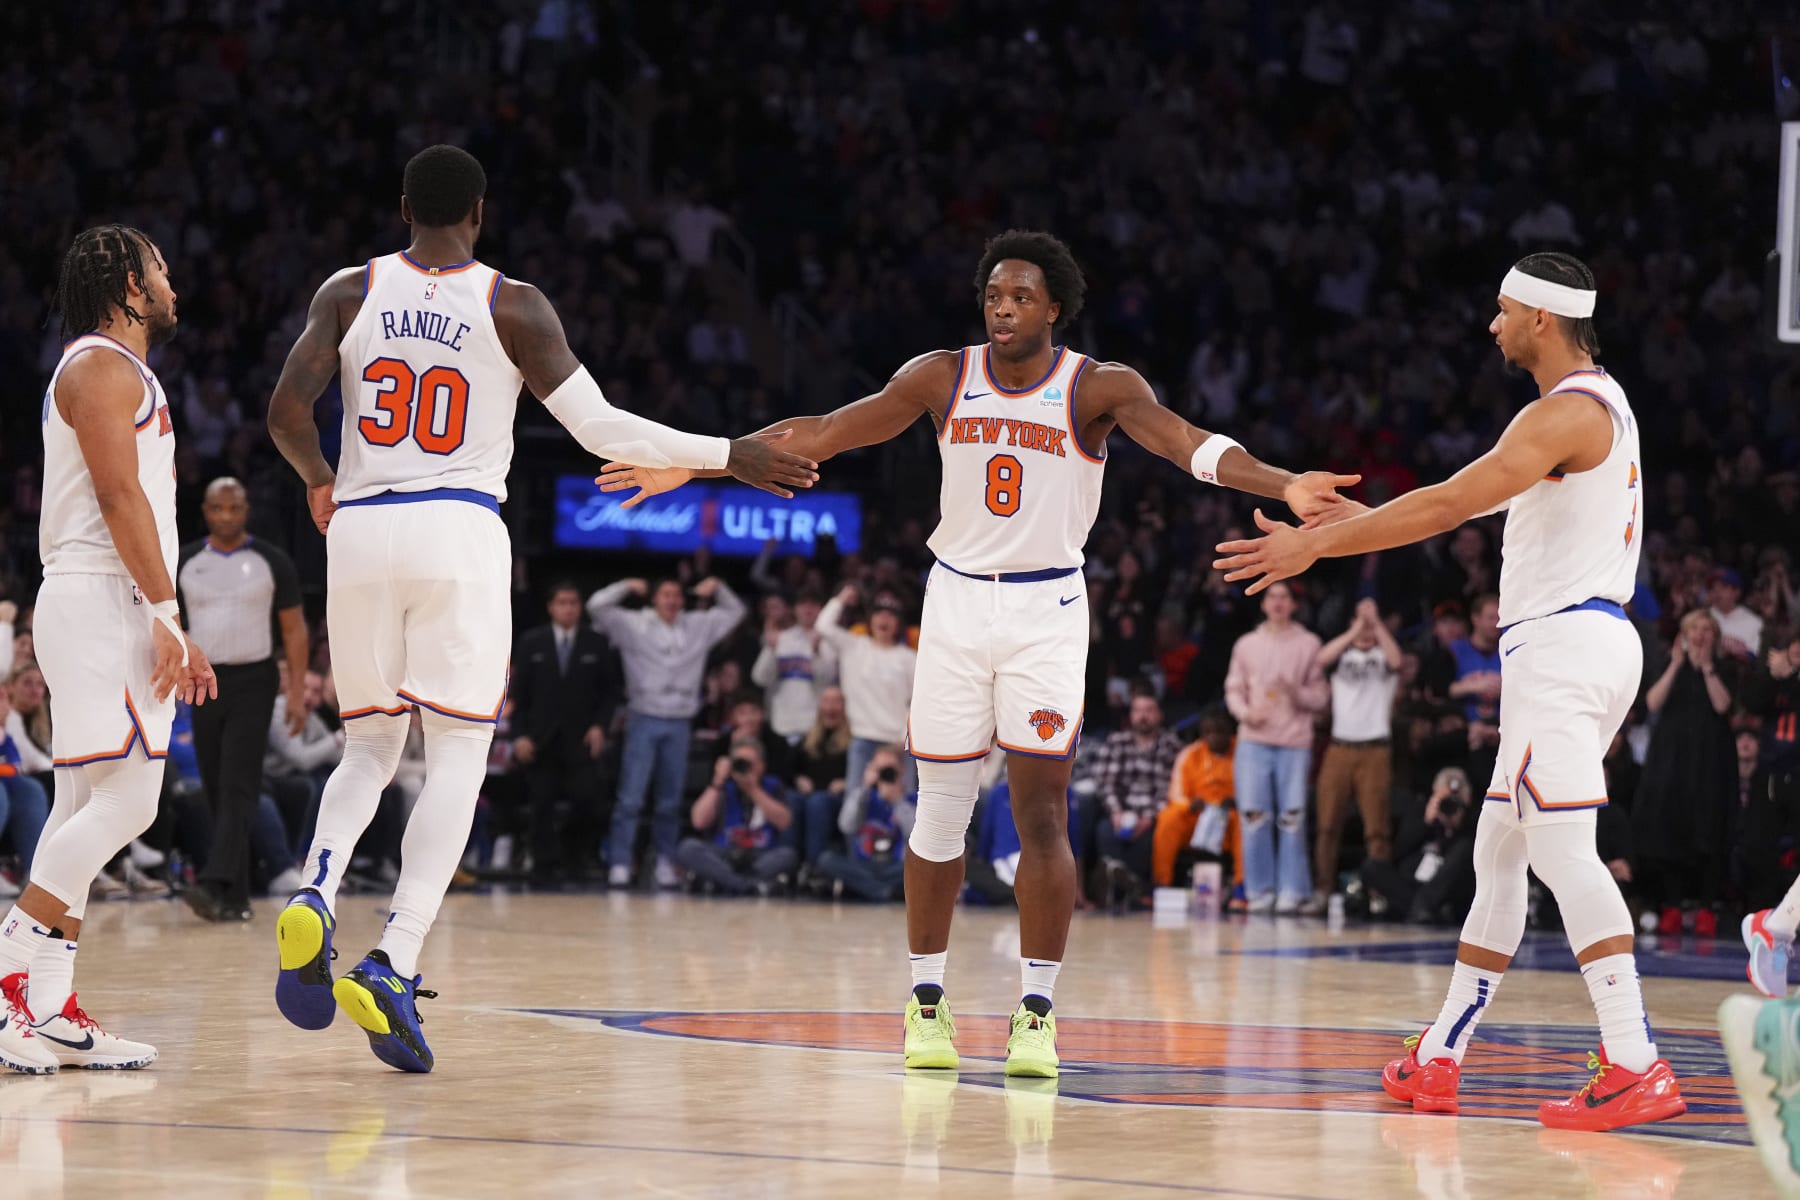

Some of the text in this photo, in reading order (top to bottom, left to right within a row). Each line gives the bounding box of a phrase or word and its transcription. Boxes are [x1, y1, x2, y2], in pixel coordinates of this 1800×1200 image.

[381, 310, 471, 352] RANDLE
[358, 356, 470, 456] 30
[1040, 400, 1064, 408] sphere
[950, 417, 1067, 458] NEW YORK
[985, 453, 1023, 518] 8
[723, 504, 837, 542] ULTRA
